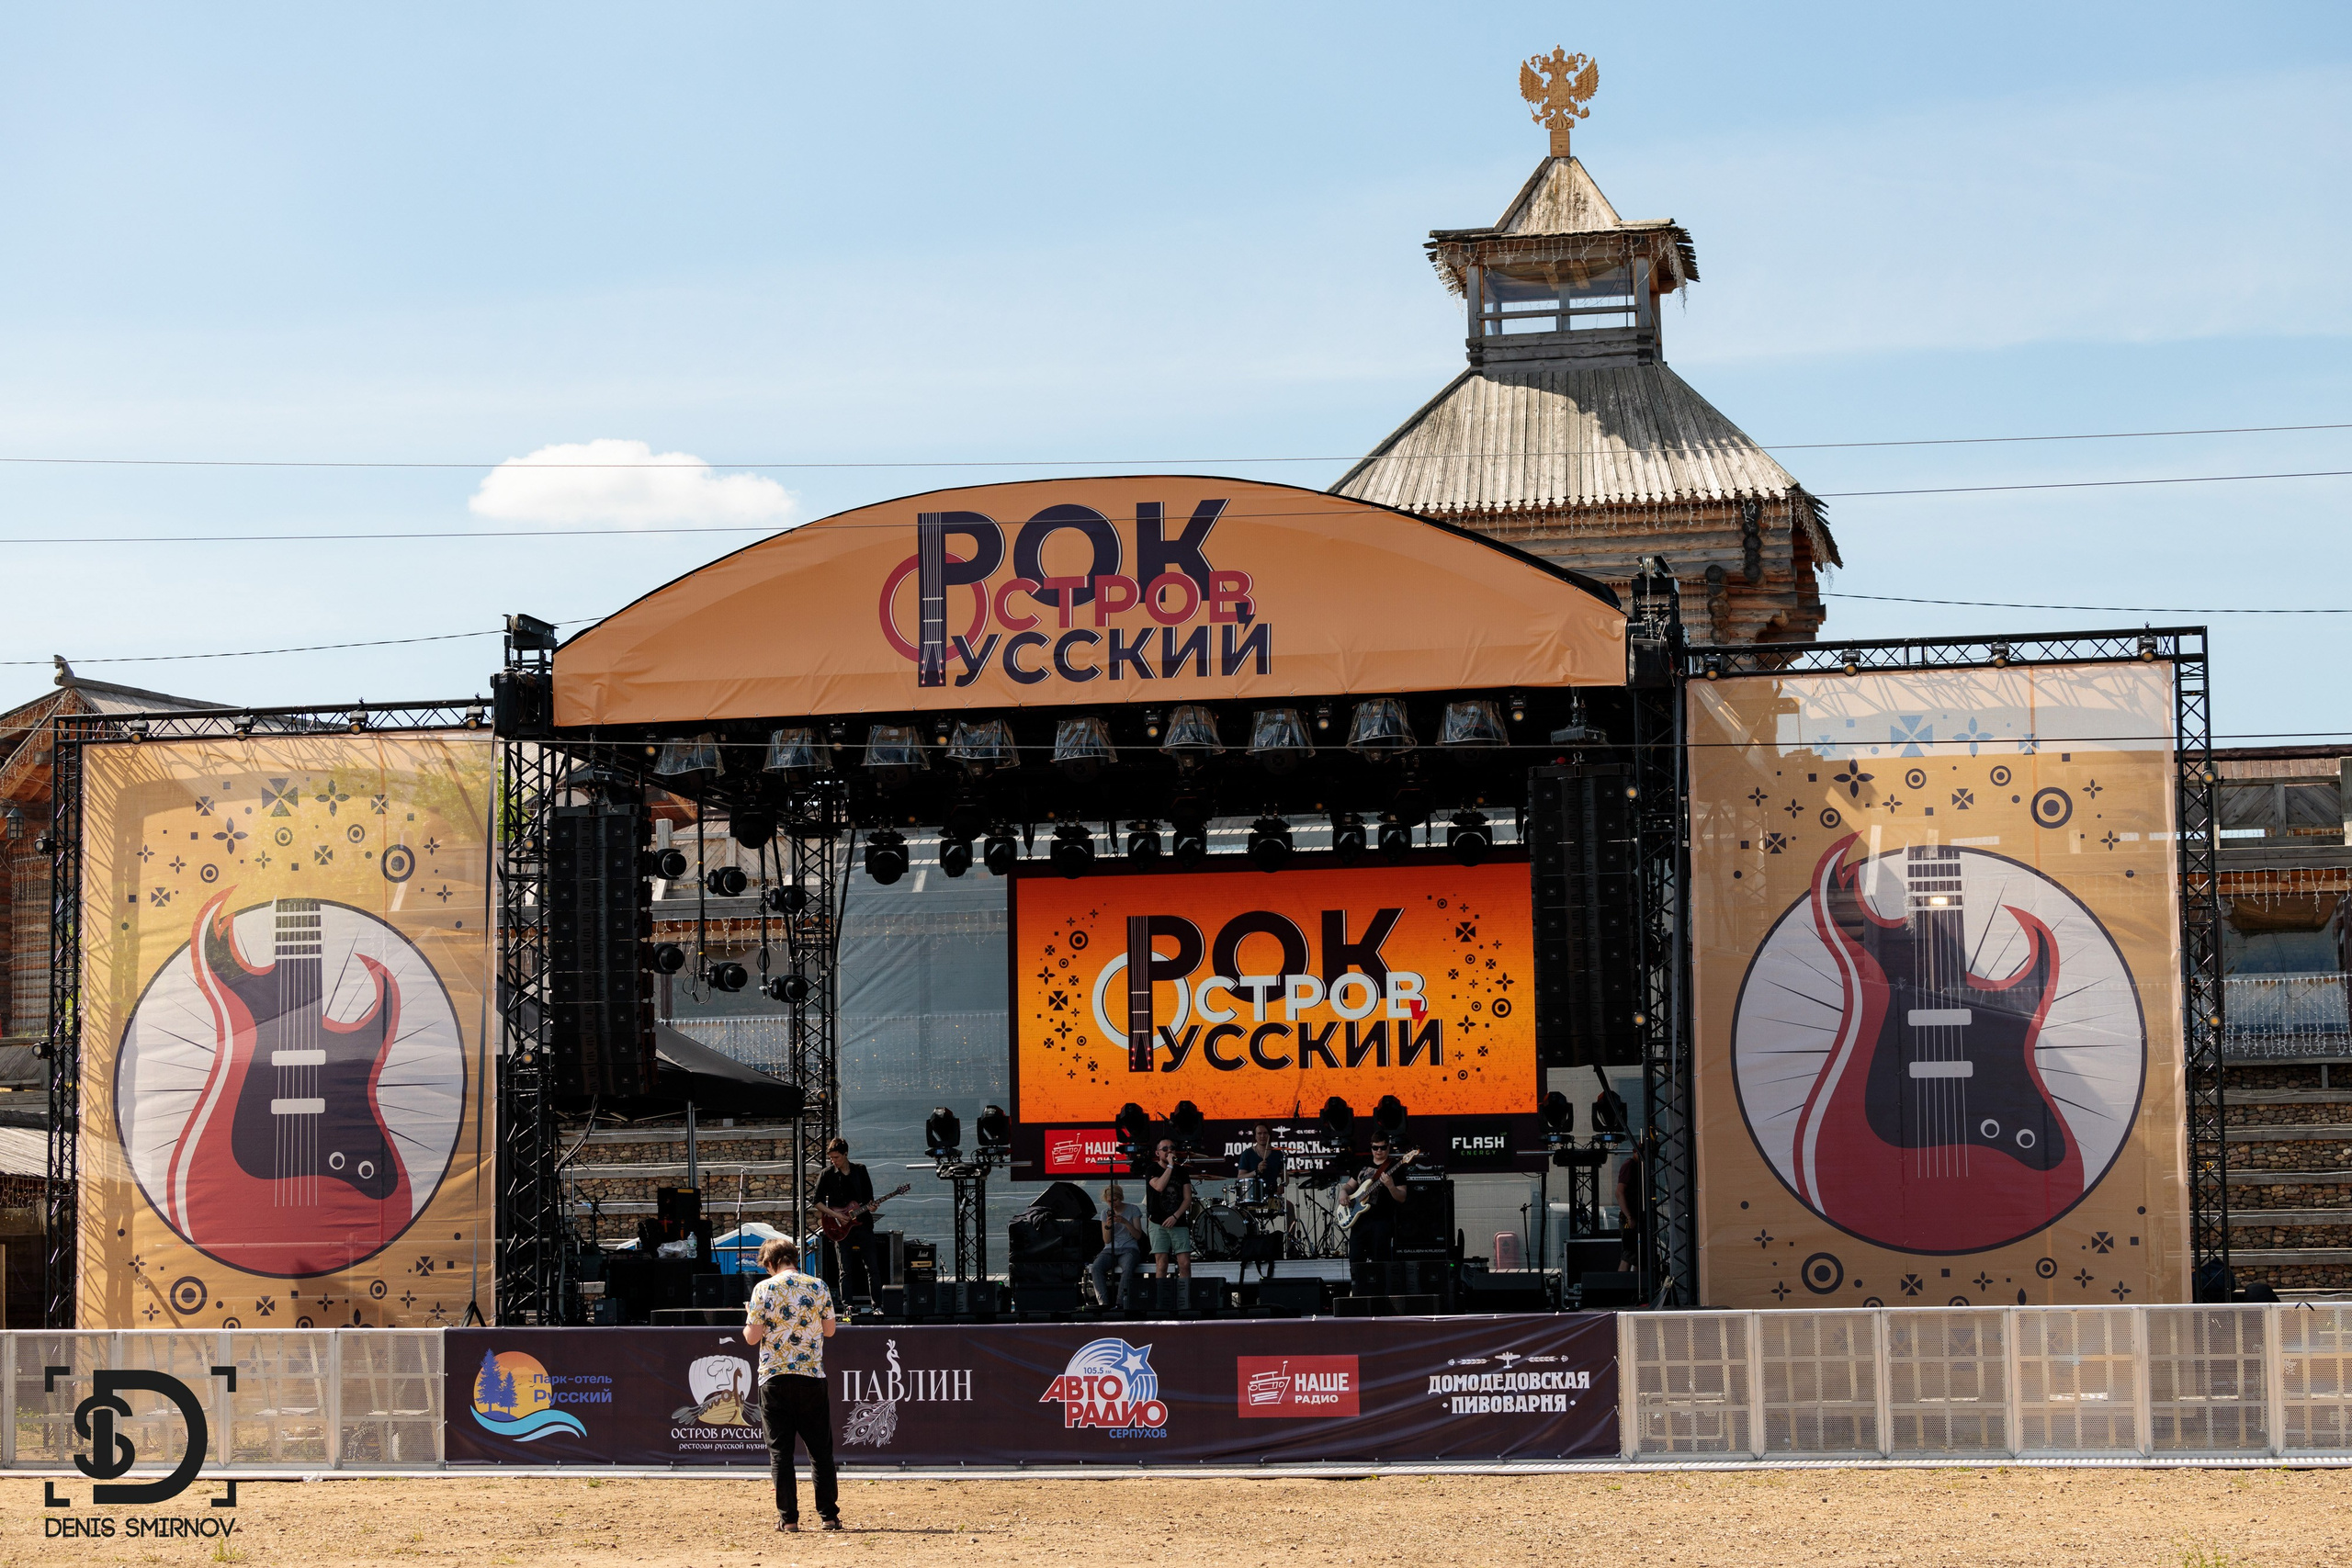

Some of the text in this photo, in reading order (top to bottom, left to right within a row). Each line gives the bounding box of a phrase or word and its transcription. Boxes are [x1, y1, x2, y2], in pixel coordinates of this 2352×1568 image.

[918, 499, 1231, 687] РОК
[1126, 908, 1406, 1072] РОК
[1452, 1136, 1505, 1149] FLASH
[533, 1373, 613, 1386] Парк-отель
[842, 1369, 973, 1402] ПАВЛИН
[1039, 1375, 1124, 1402] АВТО
[1295, 1372, 1350, 1392] НАШЕ
[1428, 1371, 1590, 1394] ДОМОДЕДОВСКАЯ
[534, 1388, 612, 1406] Русский
[1295, 1394, 1339, 1404] РАДИО
[1451, 1393, 1567, 1414] ПИВОВАРНЯ
[1066, 1400, 1168, 1427] РАДИО
[671, 1427, 764, 1439] ОСТРОВ РУССК
[1109, 1428, 1168, 1438] СЕРПУХОВ
[679, 1442, 767, 1451] ресторан русской кухни
